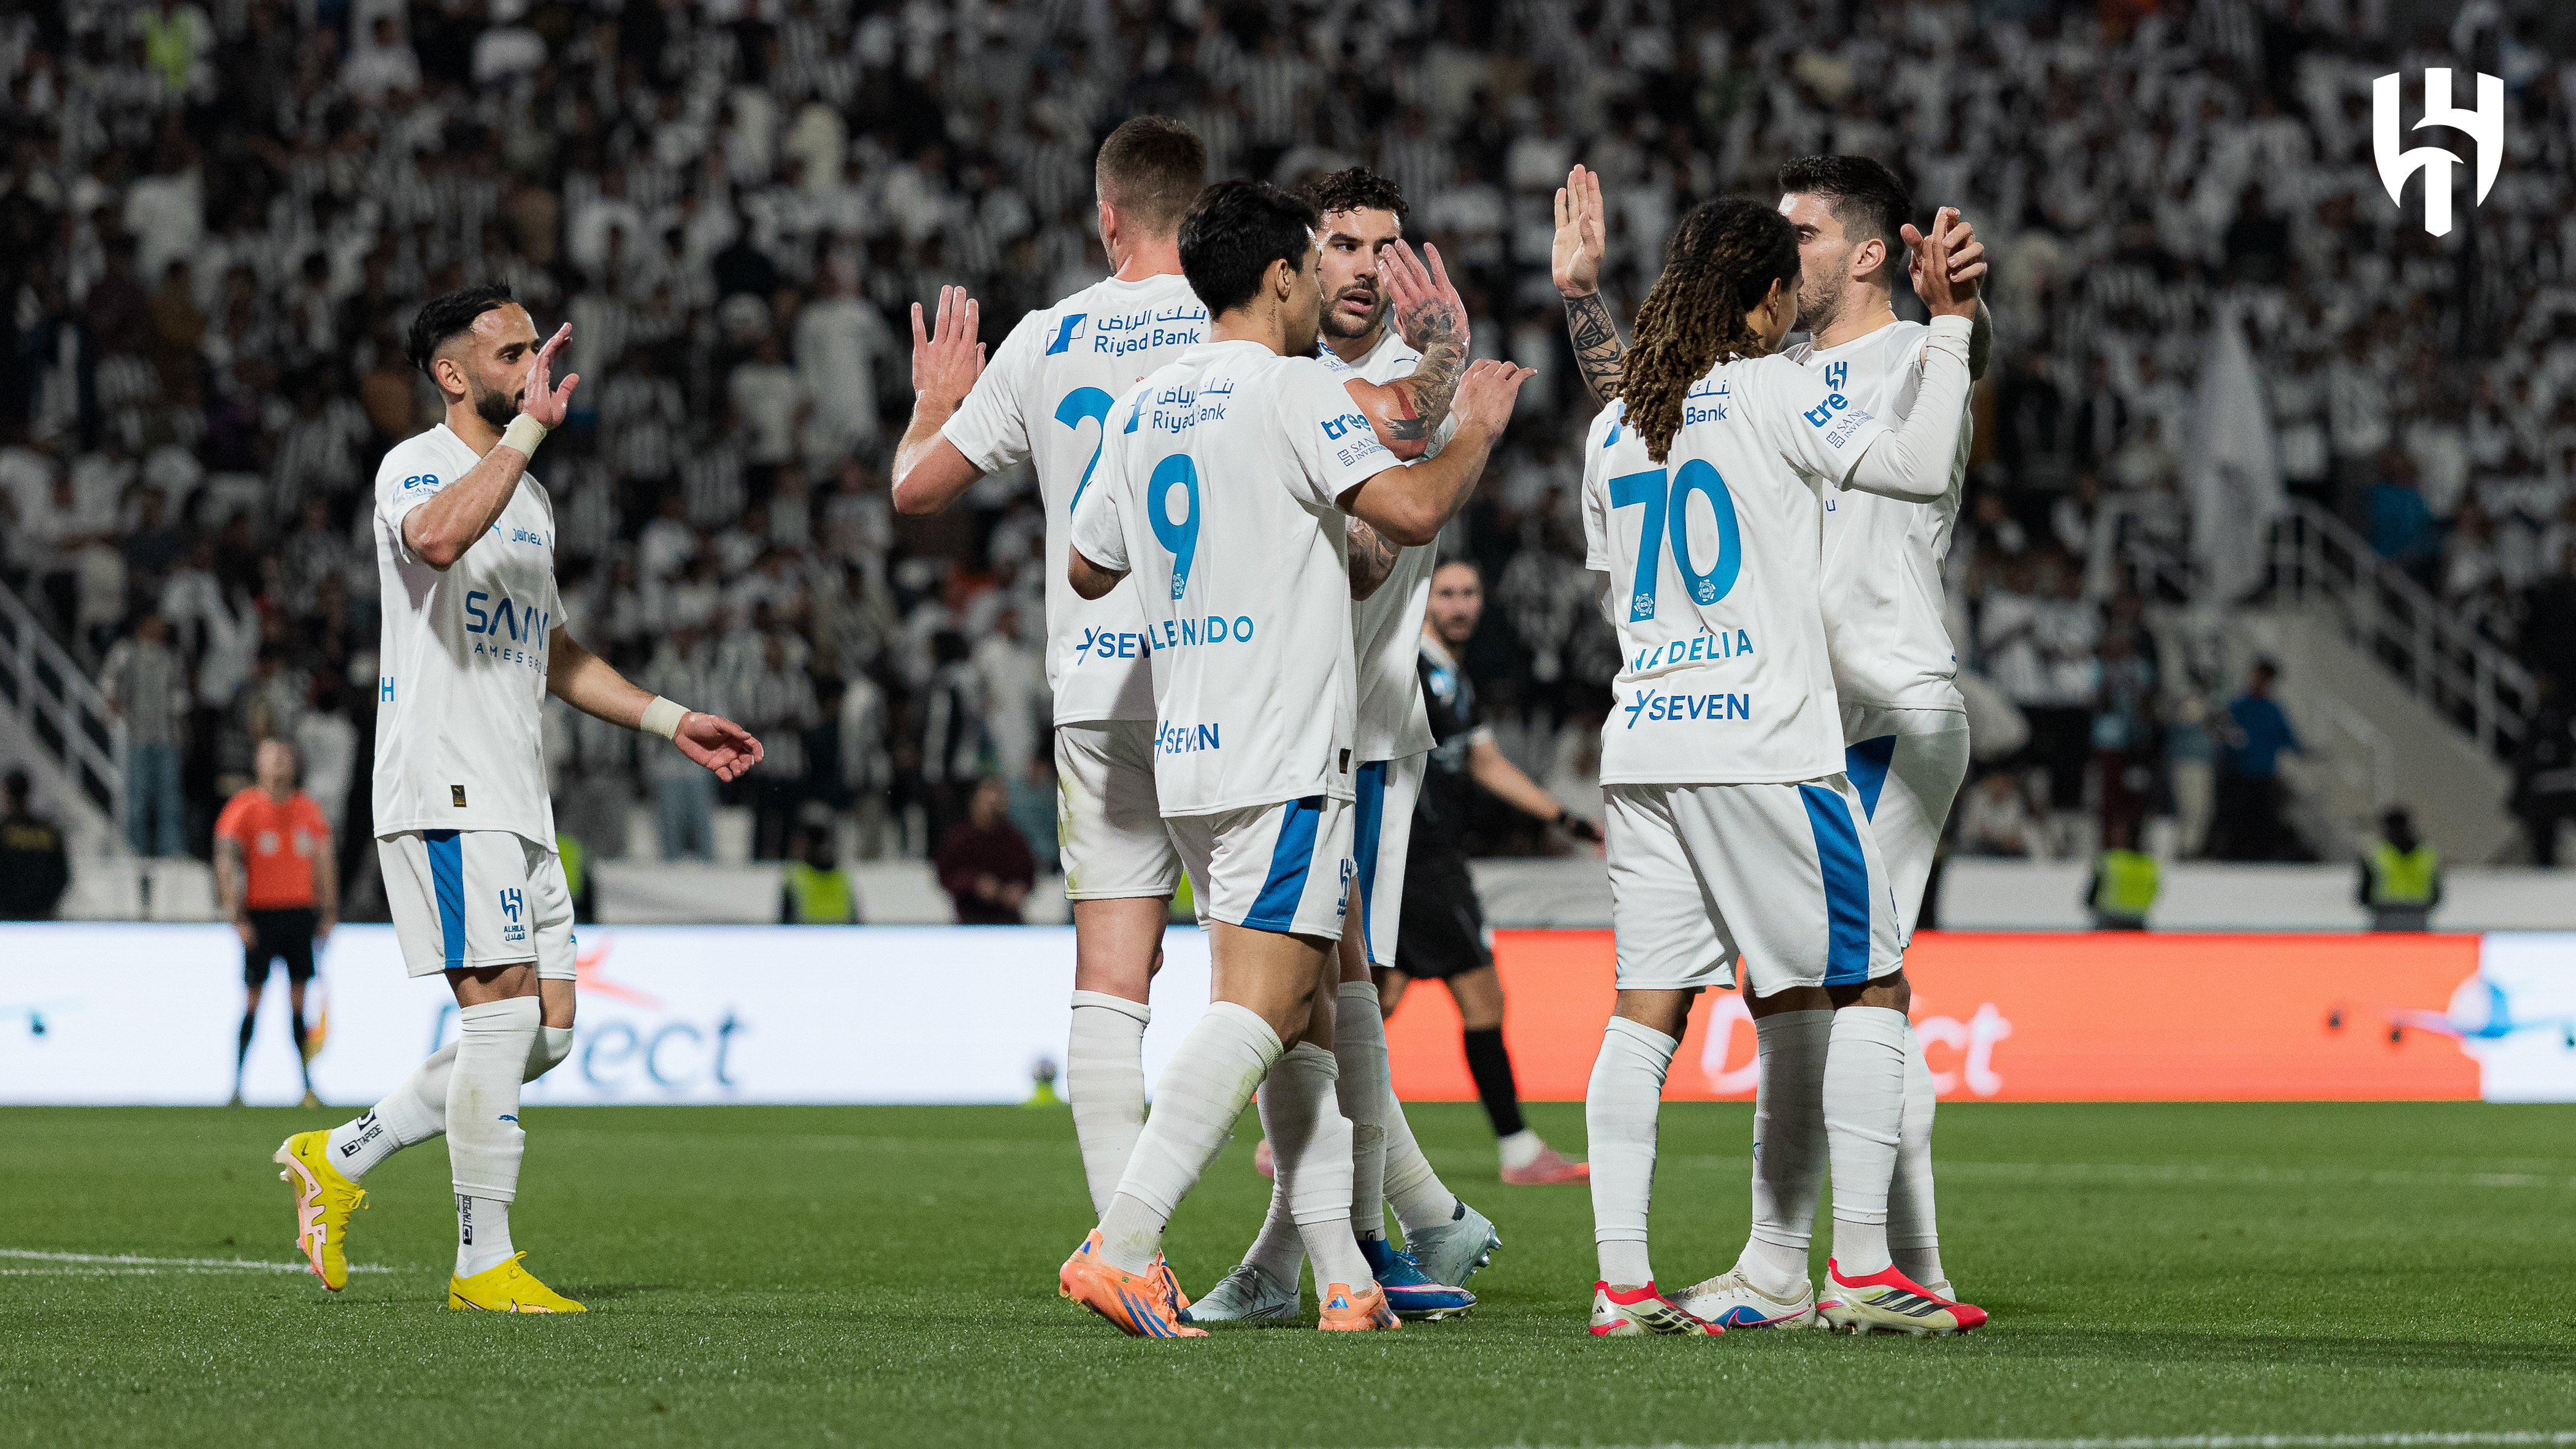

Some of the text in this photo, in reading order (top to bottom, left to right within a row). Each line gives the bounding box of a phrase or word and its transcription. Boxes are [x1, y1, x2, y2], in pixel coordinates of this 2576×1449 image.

[1097, 306, 1206, 334] بنك الرياض
[1094, 328, 1200, 356] Riyad Bank
[1157, 386, 1197, 408] رياض
[1803, 394, 1848, 428] tre
[1152, 403, 1226, 433] Riyad ank
[1321, 413, 1371, 440] tree
[1686, 403, 1728, 425] Bank
[1054, 386, 1115, 525] 2
[1148, 454, 1200, 599] 9
[1608, 459, 1741, 622] 70
[466, 591, 548, 651] SAVV
[1149, 616, 1253, 650] LENDO
[474, 642, 548, 675] AMES GROU
[1701, 992, 2012, 1096] Dct
